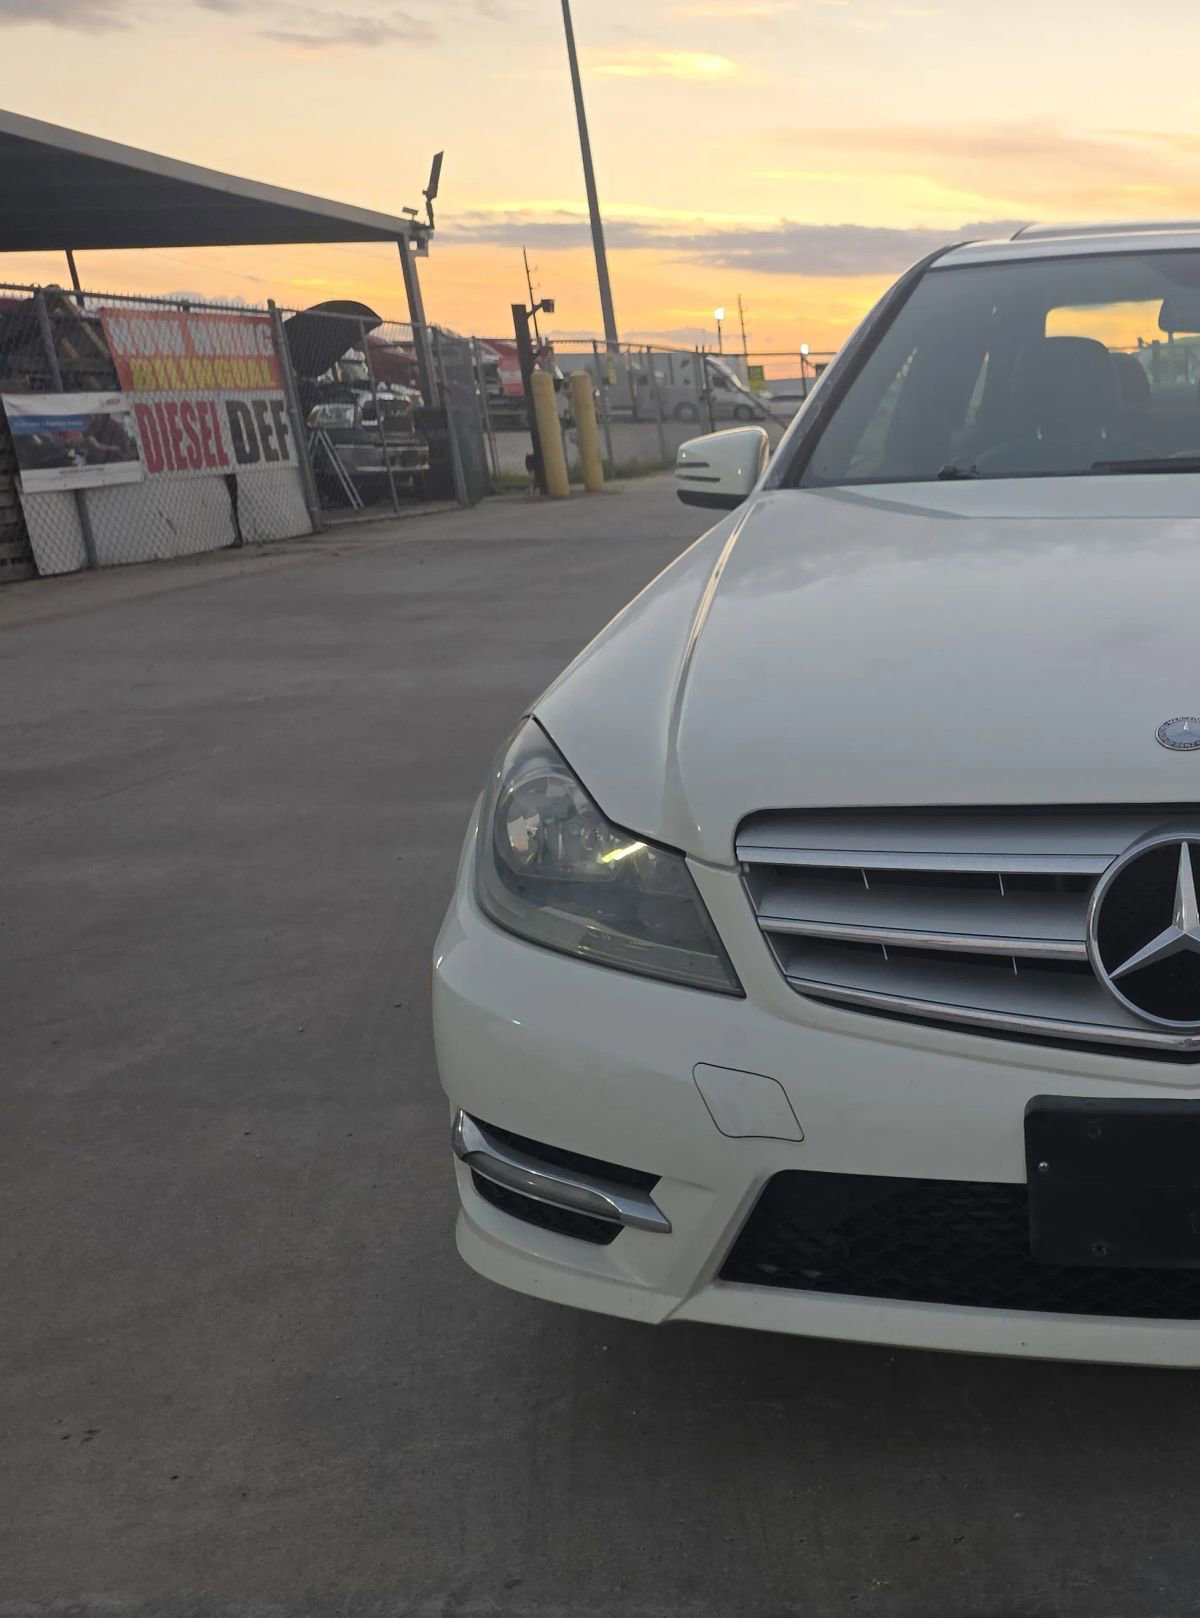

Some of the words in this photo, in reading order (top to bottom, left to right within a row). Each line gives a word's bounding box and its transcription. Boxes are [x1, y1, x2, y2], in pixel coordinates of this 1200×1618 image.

[108, 318, 185, 356] NOW
[188, 320, 274, 357] HIRING
[130, 358, 276, 390] BILINGUAL
[134, 399, 230, 474] DIESEL
[225, 400, 290, 464] DEF
